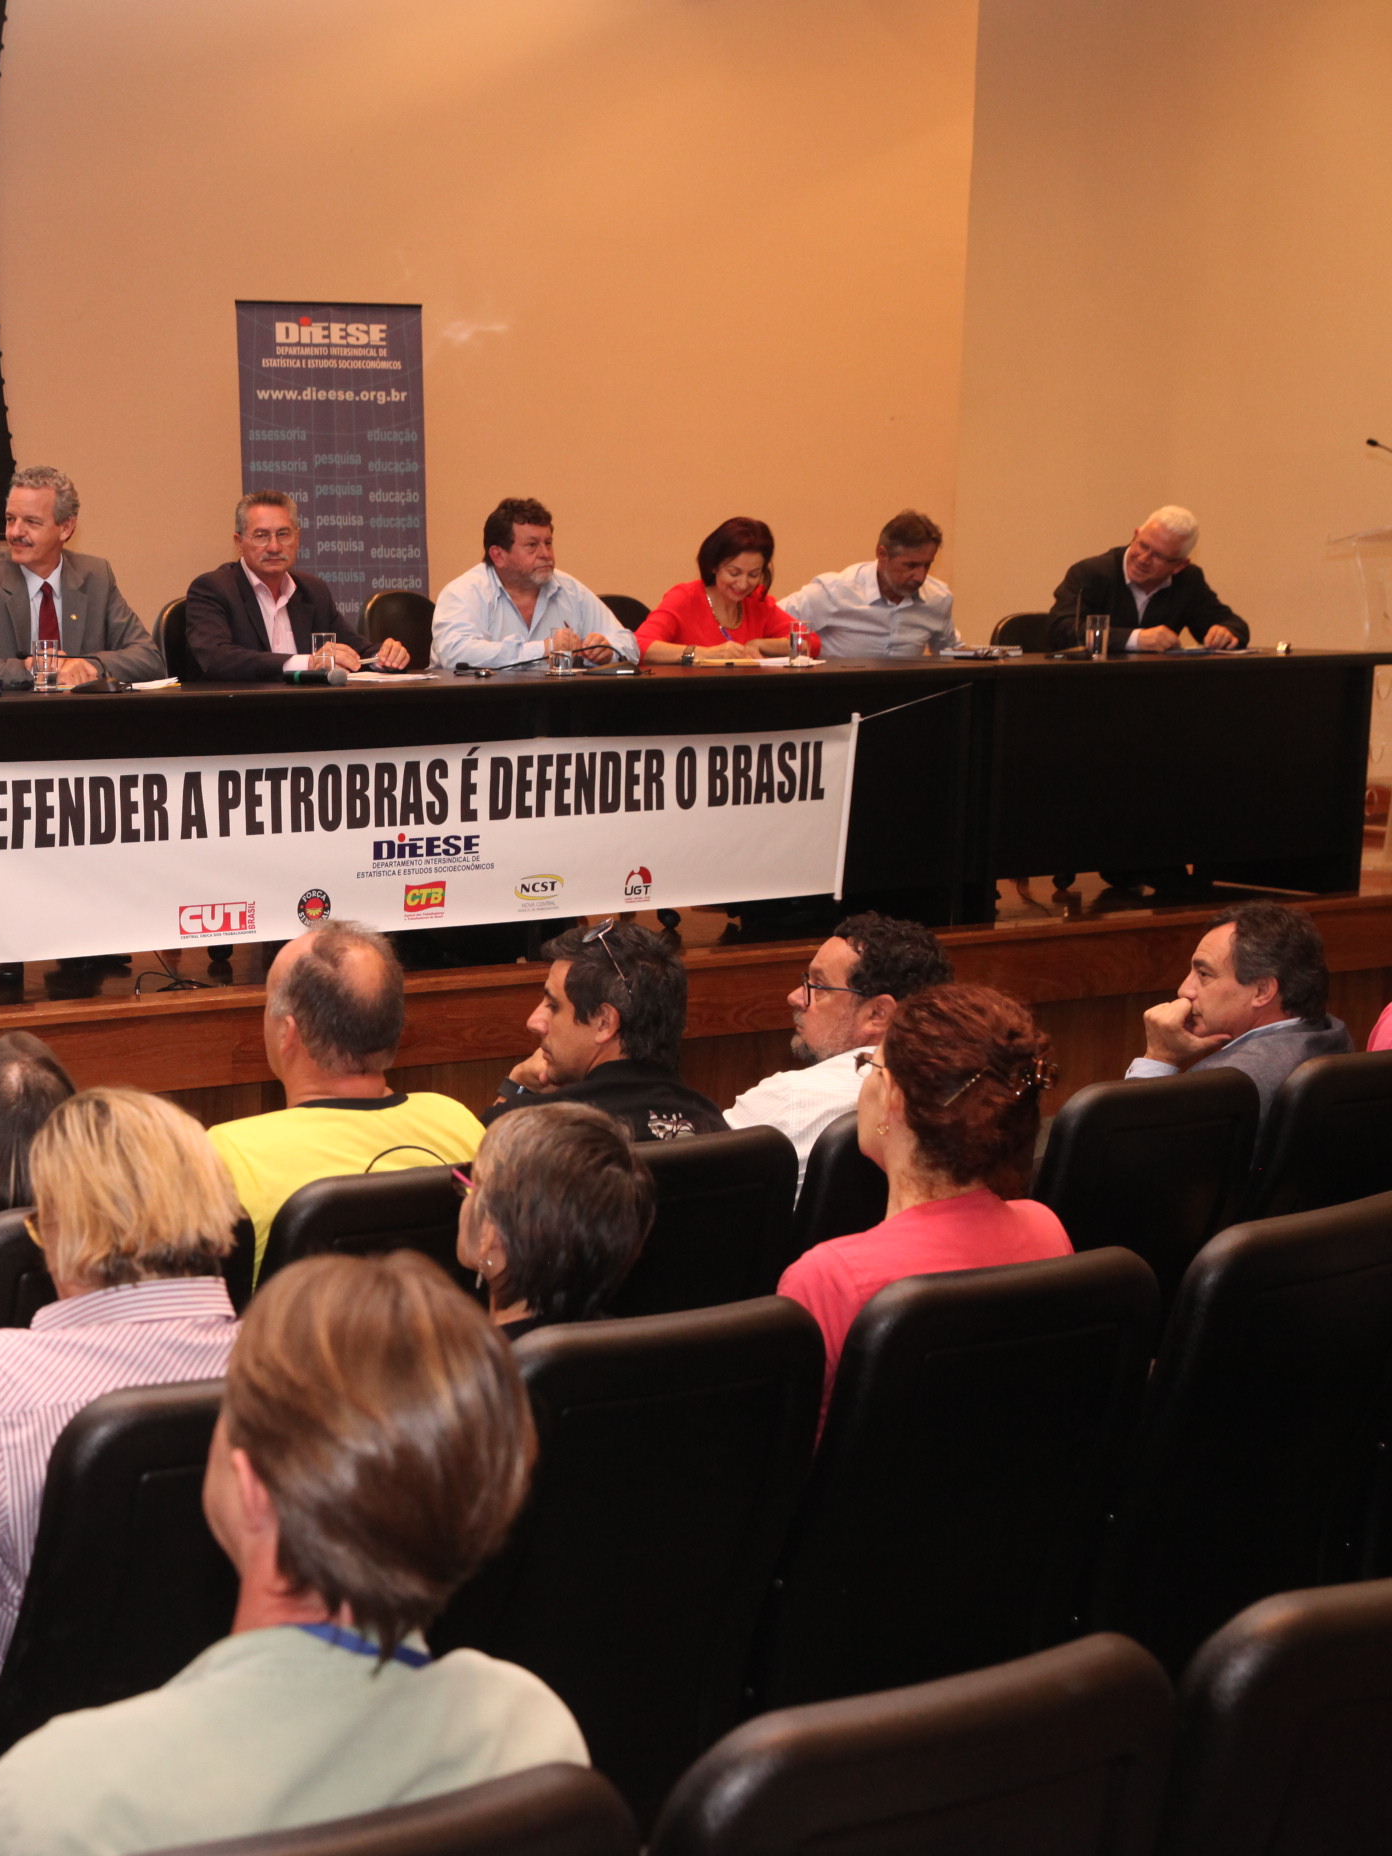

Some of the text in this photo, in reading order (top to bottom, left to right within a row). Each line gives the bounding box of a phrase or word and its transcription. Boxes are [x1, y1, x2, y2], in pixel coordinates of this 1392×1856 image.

[276, 346, 387, 357] DEPARTAMENTO INTERSINDICAL DE
[262, 357, 401, 369] ESTATÍSTICA E ESTUDOS SOCIOECONÔMICOS
[256, 387, 407, 404] www.dieese.org.br
[248, 427, 307, 441] assessoria
[367, 428, 418, 445] educação
[250, 458, 308, 472] assessoria
[314, 452, 362, 468] pesquisa
[368, 459, 418, 475] educação
[315, 482, 363, 498] pesquisa
[369, 488, 420, 505] educação
[316, 512, 364, 530] pesquisa
[369, 514, 420, 532] educação
[317, 538, 365, 555] pesquisa
[370, 544, 421, 561] educação
[318, 568, 365, 584] pesquisa
[371, 574, 422, 589] educação
[180, 771, 208, 840] A
[218, 758, 448, 838] PETROBRAS
[460, 746, 481, 822] É
[489, 748, 666, 821] DEFENDER
[675, 746, 697, 810] O
[708, 740, 825, 808] BRASIL
[356, 862, 495, 879] ESTATÍSTICA E ESTUDOS SOCIOECONÔMICOS
[372, 859, 423, 869] DEPARTAMENTO
[424, 856, 470, 865] INTERSINDICAL
[520, 881, 558, 893] NCST
[625, 885, 651, 895] UGT
[302, 890, 327, 902] FORÇA
[406, 887, 444, 906] CTB
[180, 903, 246, 933] CUT
[248, 901, 256, 929] BRASIL
